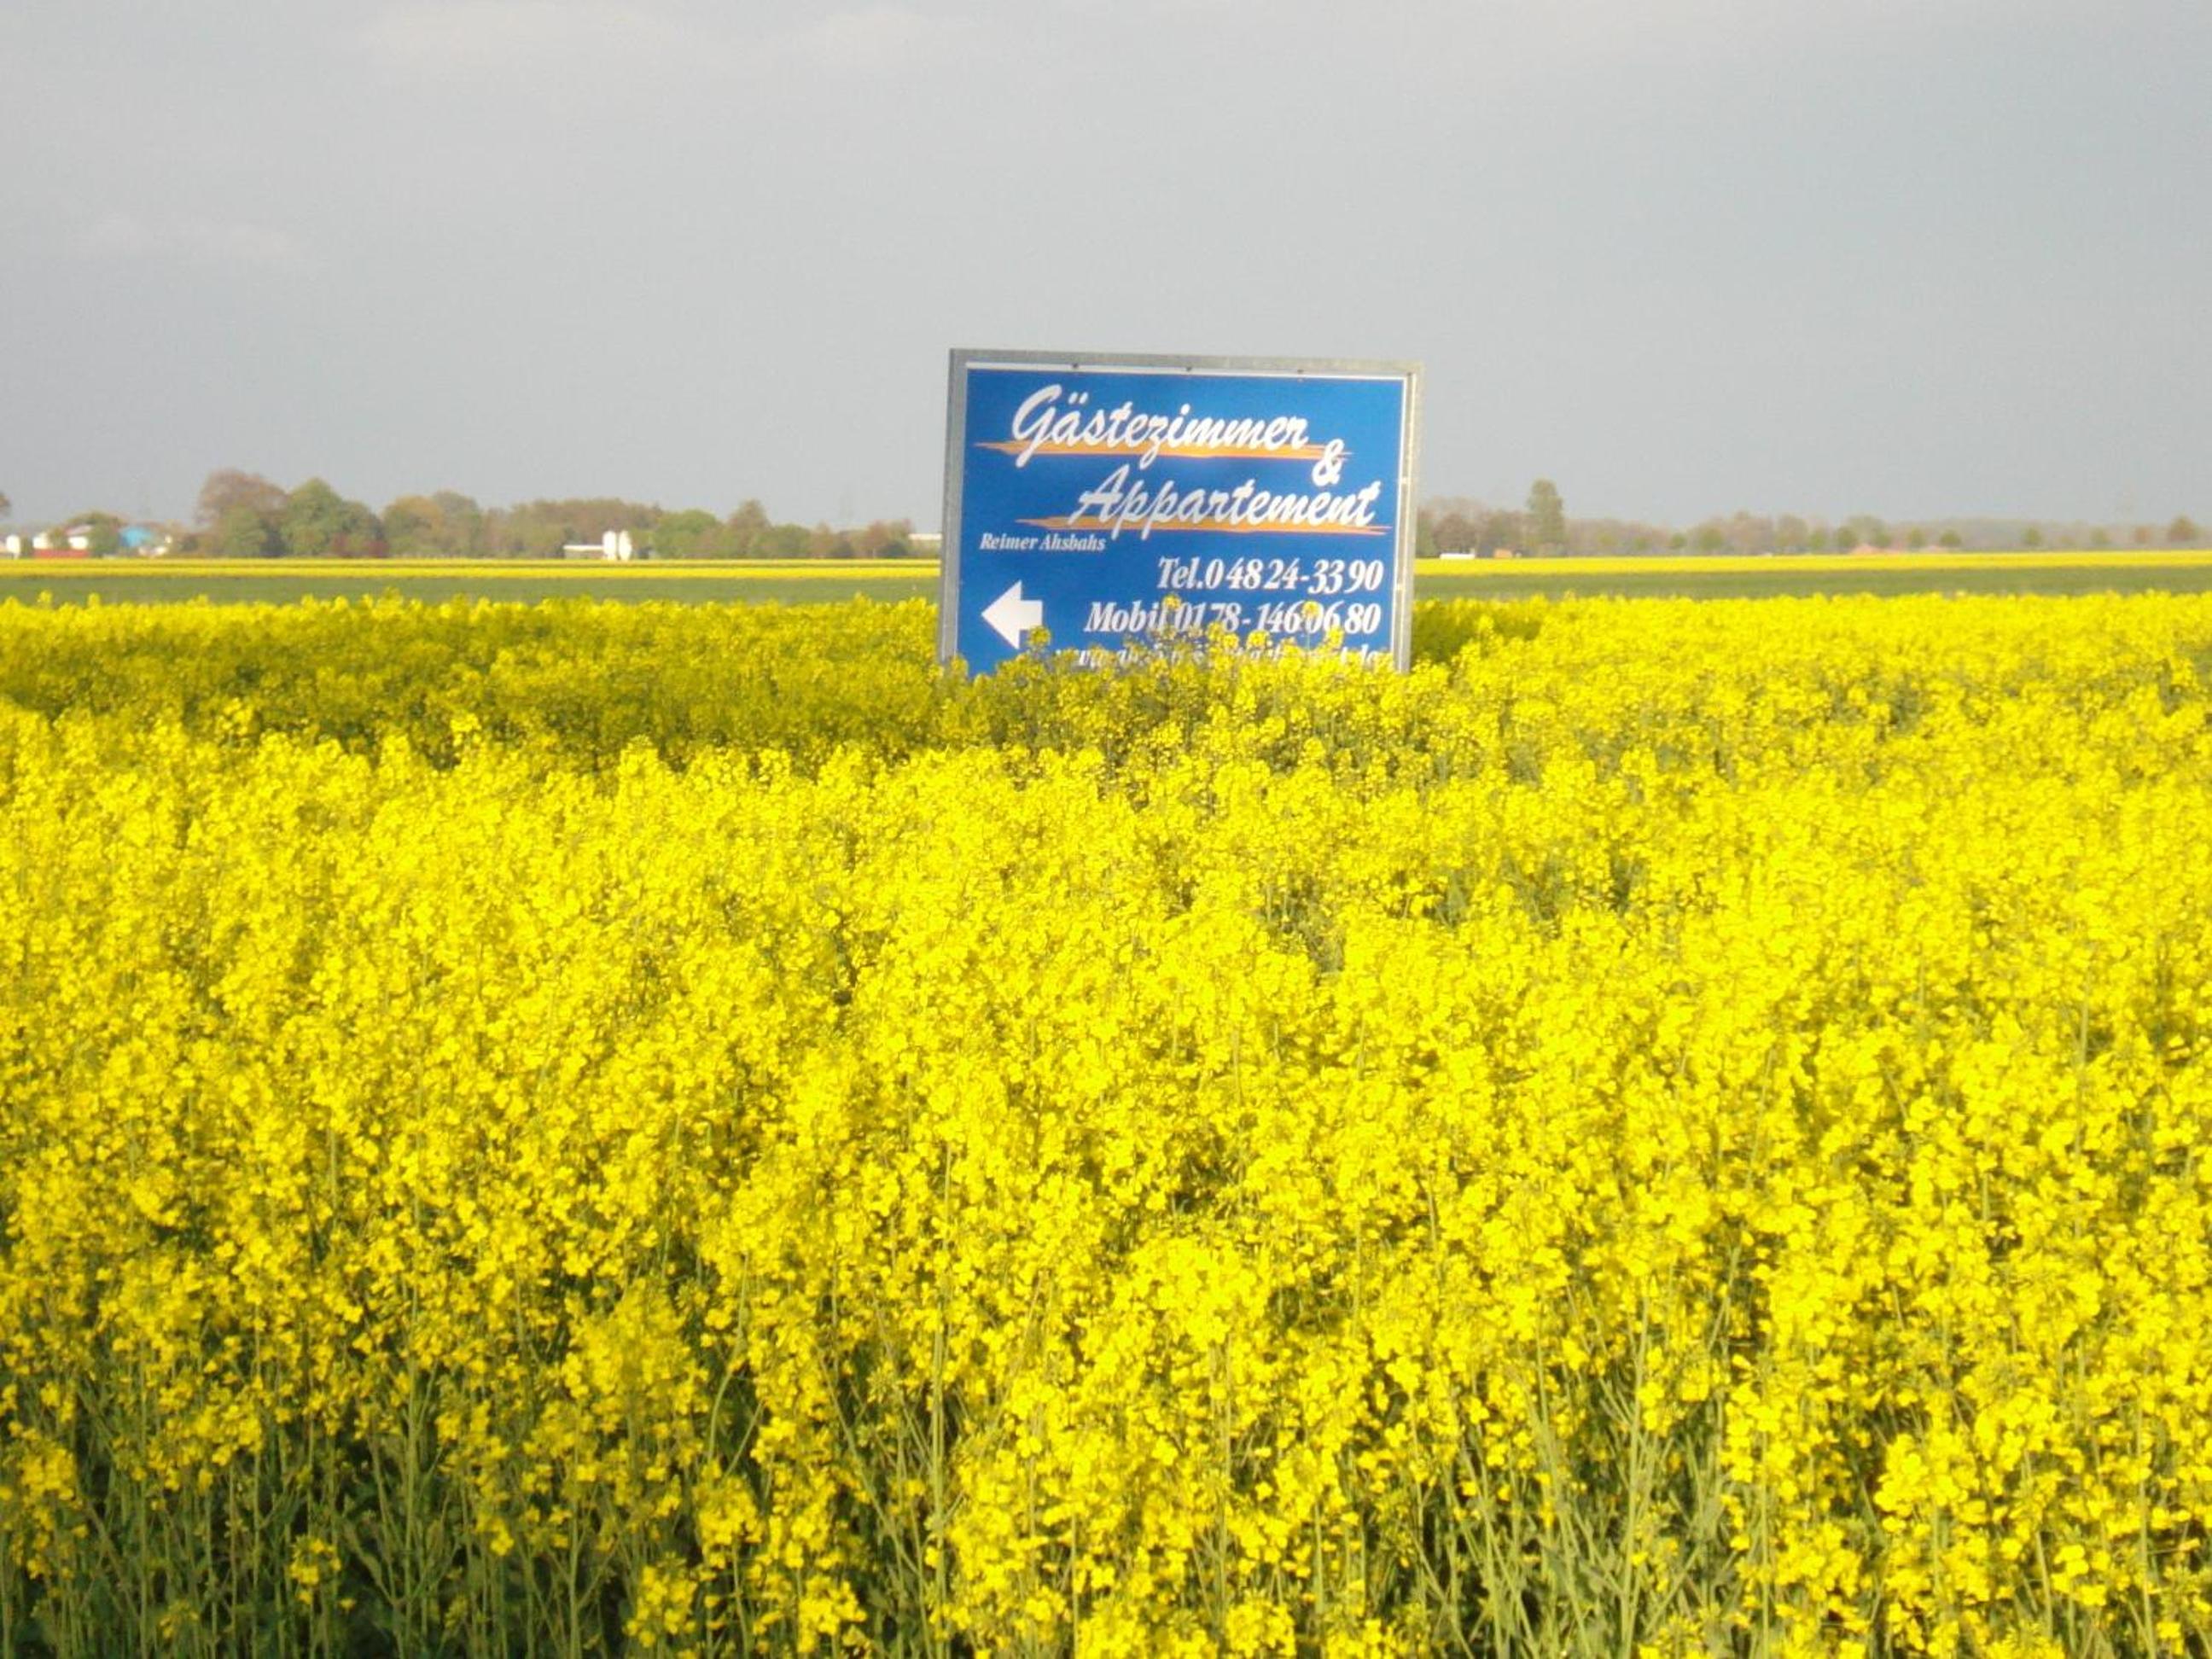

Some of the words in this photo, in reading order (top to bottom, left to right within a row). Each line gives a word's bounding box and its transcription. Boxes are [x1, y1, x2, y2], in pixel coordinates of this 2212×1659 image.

[1011, 383, 1309, 469] Gästezimmer
[1311, 438, 1346, 487] &
[1067, 463, 1381, 541] Appartement
[979, 533, 1039, 550] Reimer
[1083, 599, 1167, 634] Mobil
